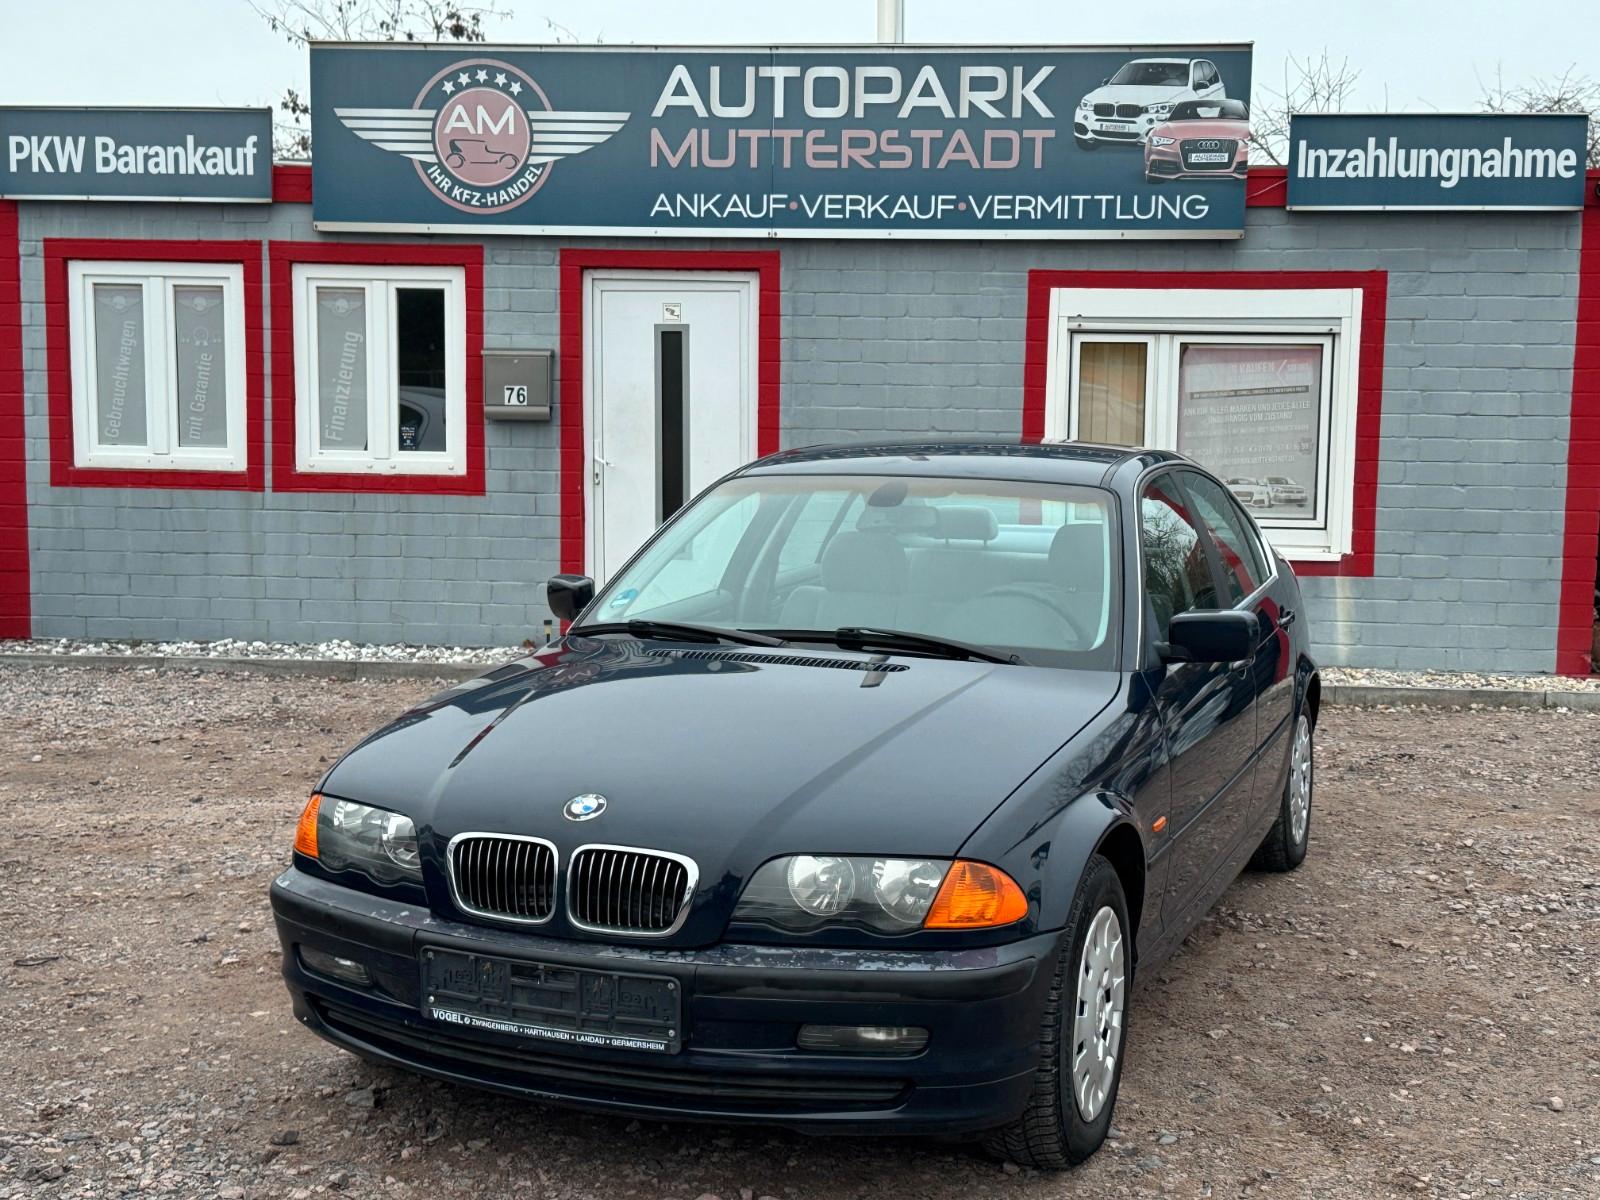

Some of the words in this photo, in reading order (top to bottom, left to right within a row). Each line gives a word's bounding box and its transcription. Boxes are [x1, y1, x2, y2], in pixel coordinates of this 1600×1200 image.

[651, 65, 1056, 119] AUTOPARK
[443, 104, 515, 136] AM
[8, 135, 85, 174] PKW
[94, 134, 258, 177] Barankauf
[650, 128, 1056, 169] MUTTERSTADT
[1297, 137, 1577, 188] Inzahlungnahme
[427, 164, 452, 193] IHR
[451, 165, 543, 207] KFZ-HANDEL
[650, 193, 788, 219] ANKAUF
[799, 194, 956, 219] VERKAUF
[966, 194, 1210, 220] VERMITTLUNG
[104, 319, 137, 438] Gebrauchtwagen
[190, 352, 213, 412] Garantie
[325, 331, 364, 441] Finanzierung
[506, 387, 526, 404] 76
[186, 416, 202, 440] mit
[433, 1009, 464, 1025] VOGEL
[471, 1018, 519, 1033] ZWINGENBERG
[524, 1027, 570, 1041] HARTHAUSEN
[576, 1034, 605, 1045] LANDAU
[611, 1038, 665, 1051] GERMERSHEIM
